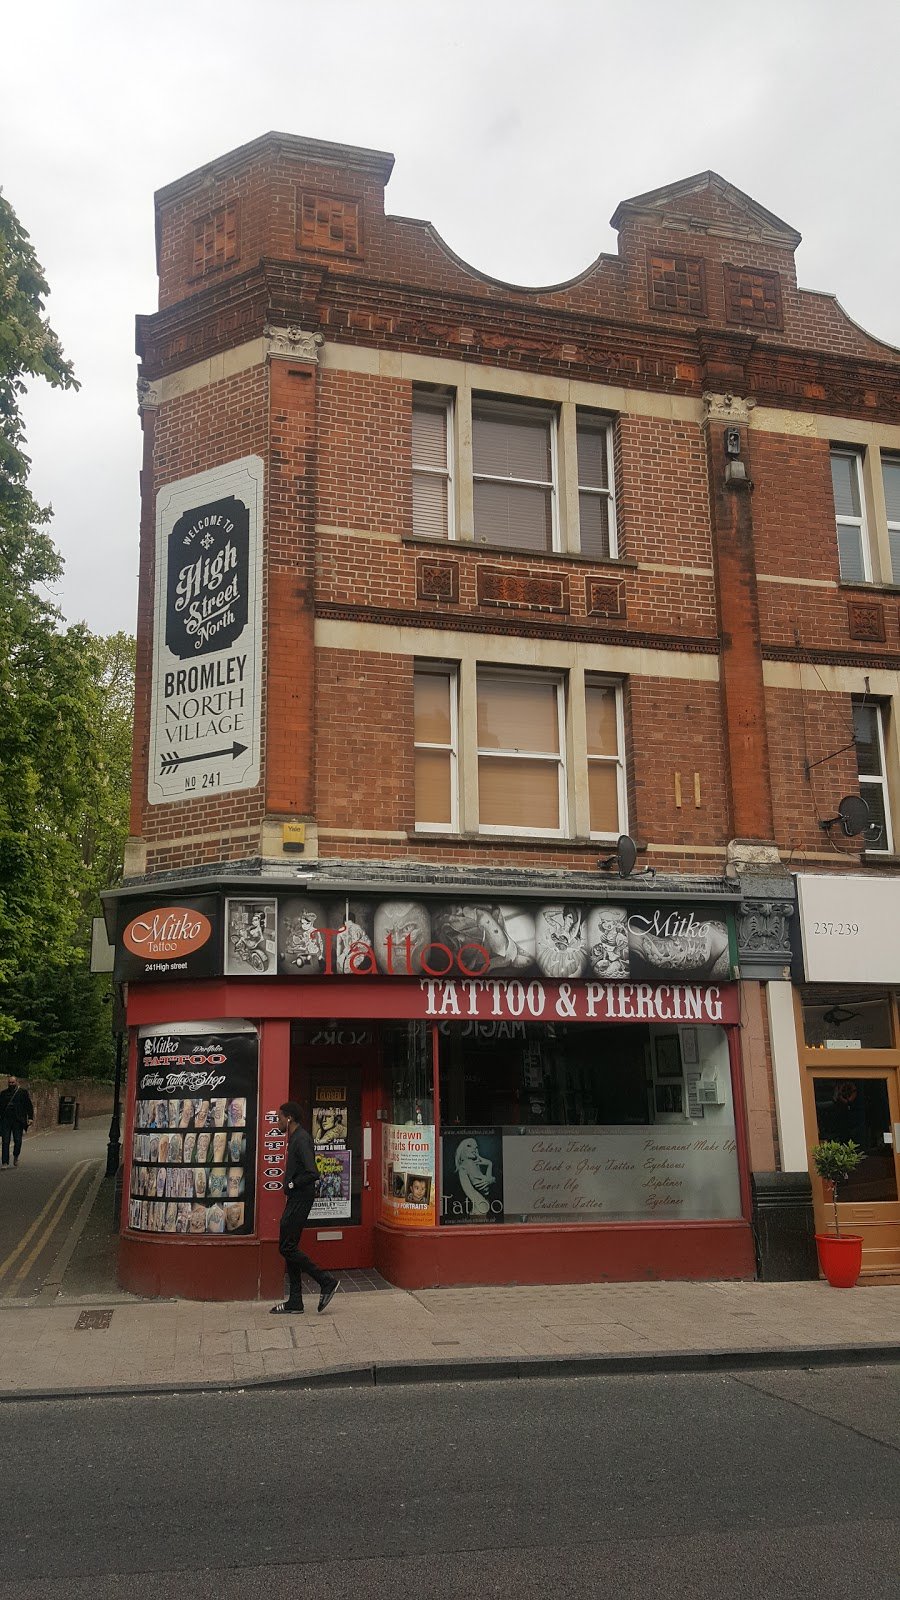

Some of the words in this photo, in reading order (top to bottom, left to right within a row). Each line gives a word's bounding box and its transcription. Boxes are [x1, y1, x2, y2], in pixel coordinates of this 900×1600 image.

[183, 515, 224, 546] WELCOME
[225, 518, 235, 534] TO
[175, 540, 239, 612] High
[184, 573, 240, 635] Street
[194, 611, 236, 650] North
[164, 654, 248, 699] BROMLEY
[164, 687, 245, 724] NORTH
[165, 712, 245, 744] VILLAGE
[201, 772, 221, 789] 241
[131, 912, 202, 944] Mitko
[627, 909, 711, 939] Mitko
[813, 922, 860, 936] 237-239
[147, 940, 178, 953] Tattoo
[310, 924, 491, 977] Tattoo
[170, 962, 188, 971] street
[420, 978, 546, 1017] TATTOO
[555, 983, 577, 1017] &
[585, 982, 723, 1020] PIERCING
[151, 1036, 180, 1054] Mitko
[143, 1054, 227, 1067] TATTOO
[189, 1069, 227, 1092] Shop
[396, 1130, 422, 1140] drawn
[408, 1141, 430, 1152] from
[567, 1141, 597, 1153] Tattoo
[642, 1140, 692, 1151] Permanent
[693, 1140, 719, 1151] Make
[723, 1140, 737, 1154] Up
[531, 1159, 564, 1172] Black
[604, 1159, 635, 1171] Tattoo
[563, 1178, 579, 1192] Up
[641, 1176, 683, 1190] Lipliner
[400, 1202, 428, 1211] PORTRAITS
[441, 1194, 504, 1215] Tattoo
[533, 1198, 568, 1210] Custom
[571, 1198, 603, 1209] Tattoo
[645, 1194, 684, 1210] Eyeliner
